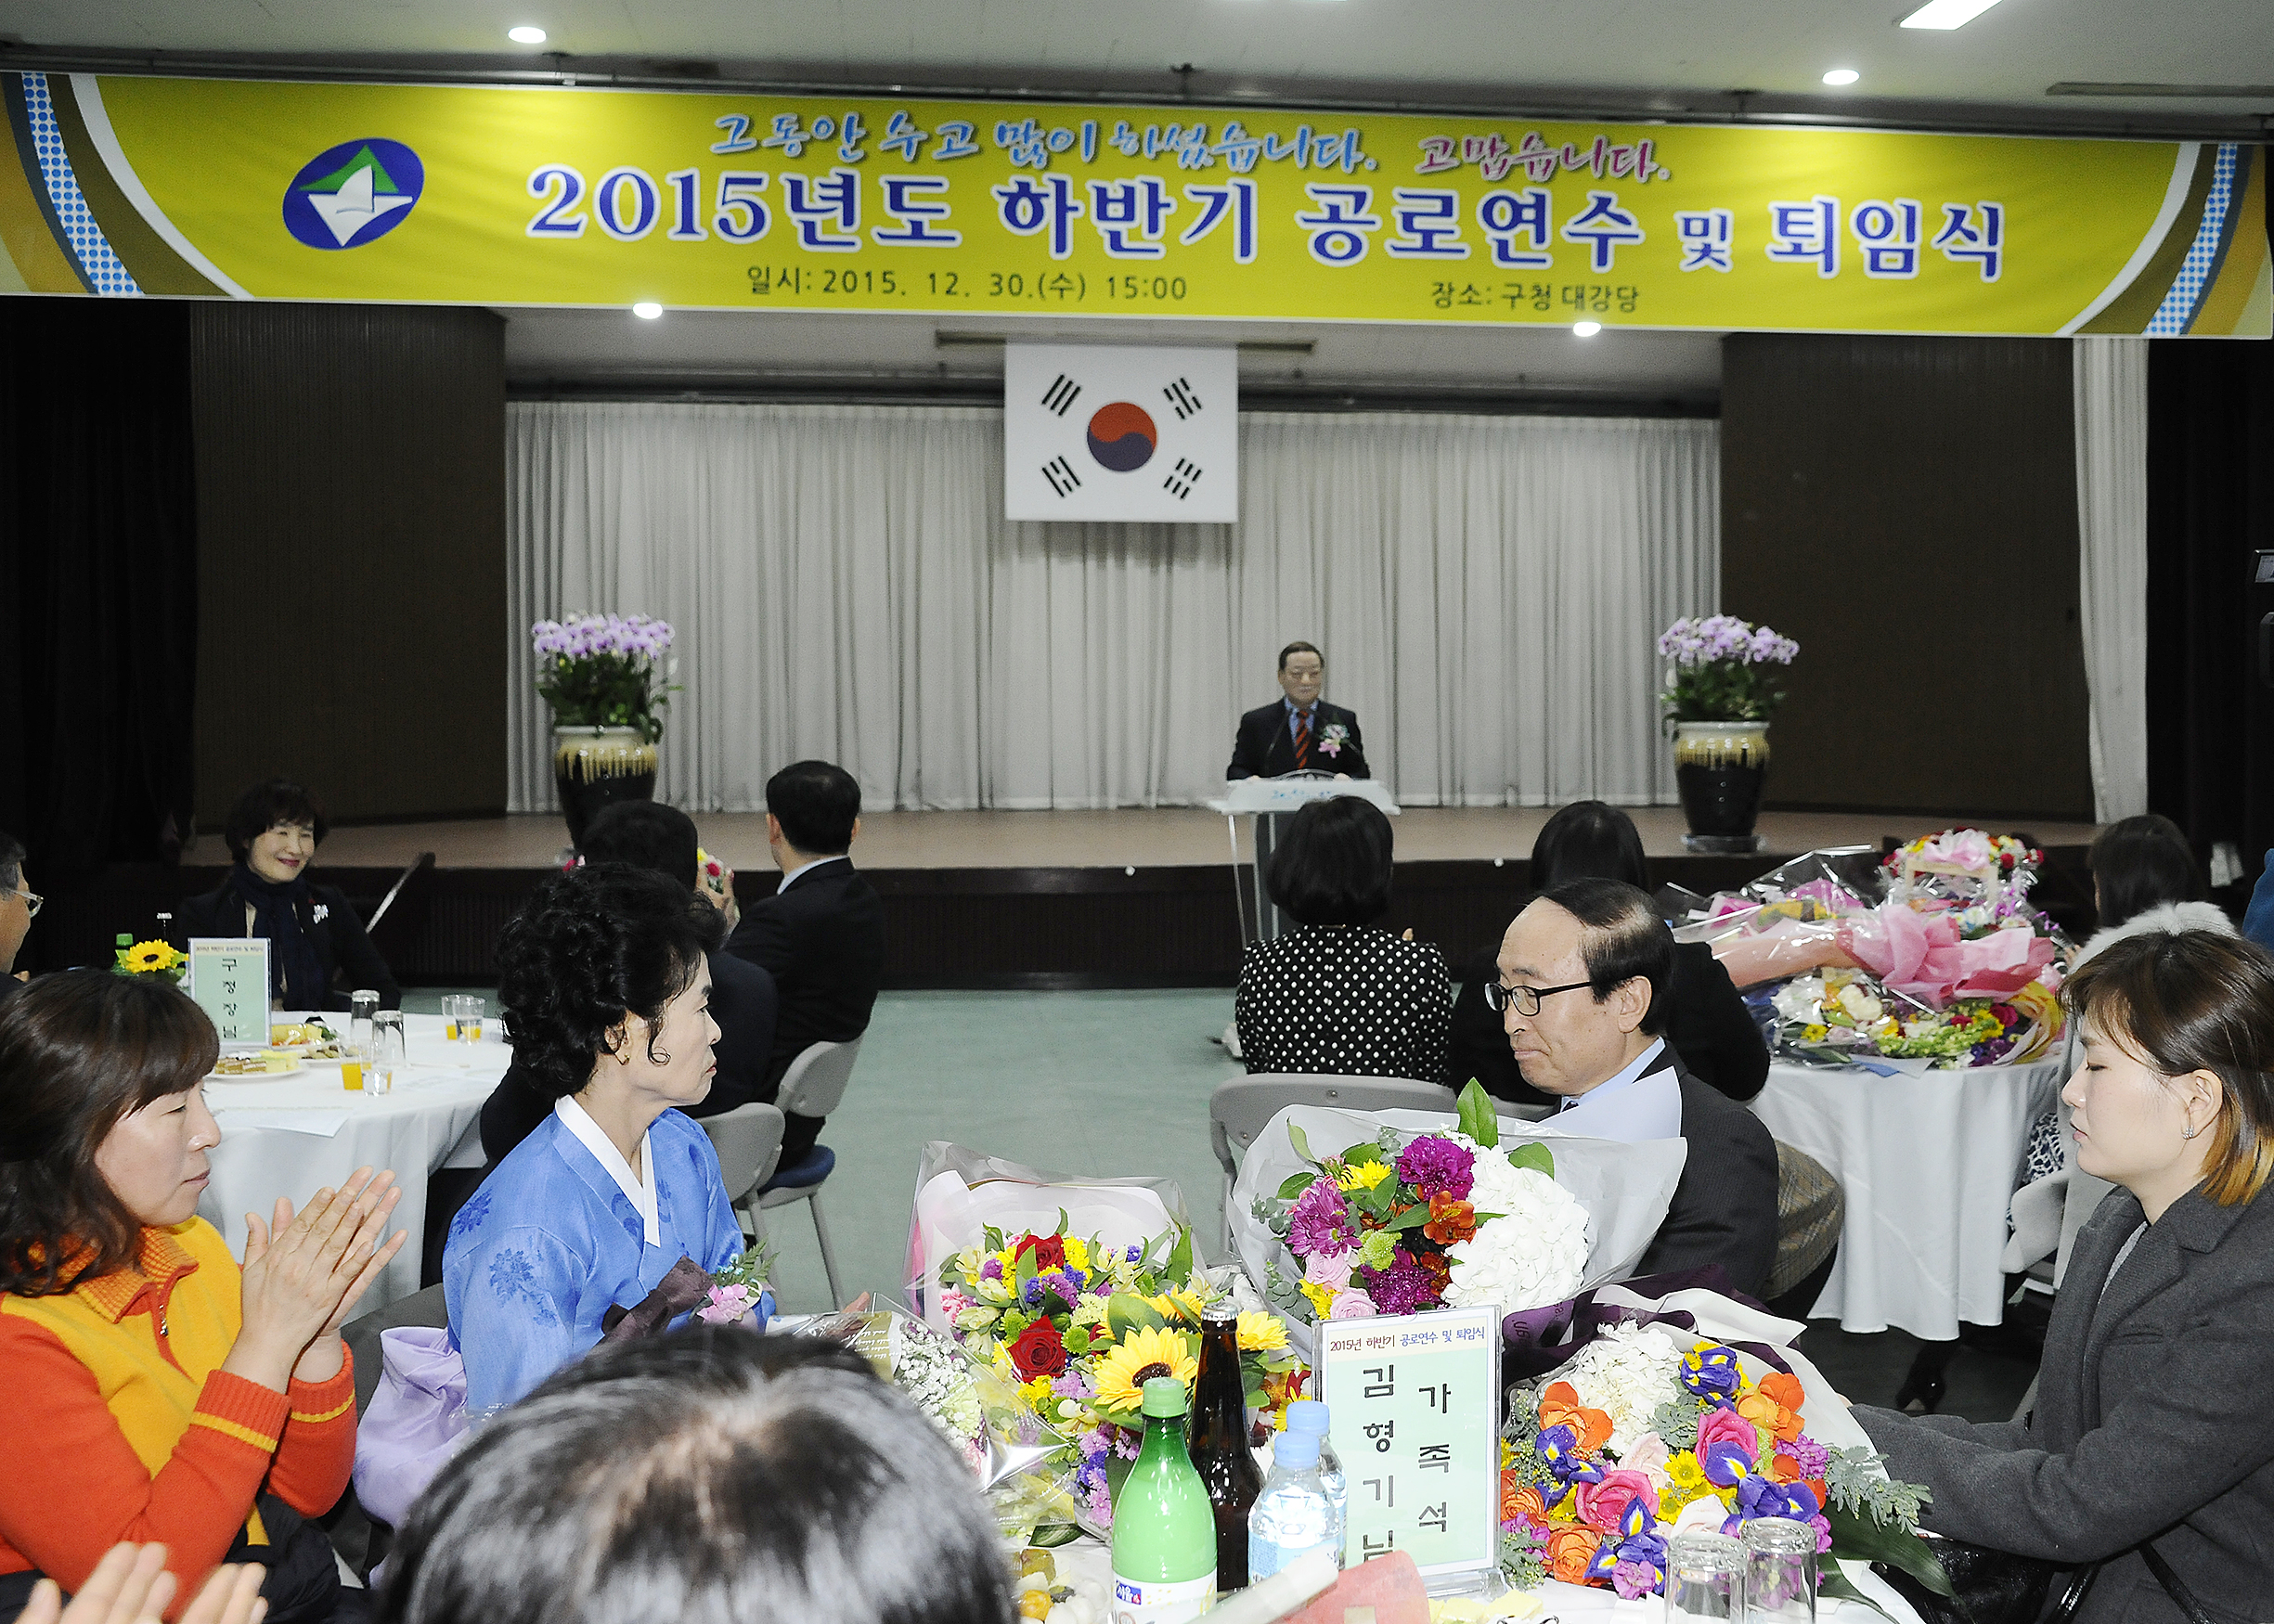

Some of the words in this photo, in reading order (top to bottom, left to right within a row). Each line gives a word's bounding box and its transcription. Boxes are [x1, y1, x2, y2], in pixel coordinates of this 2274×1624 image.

[710, 111, 867, 161] 그동안
[879, 110, 979, 161] 수고
[994, 118, 1097, 169] 많이
[1415, 133, 1671, 182] 고맙습니다.
[526, 167, 962, 251] 2015년도
[991, 172, 1259, 264] 하반기
[1296, 183, 1645, 272] 공로연수
[1674, 208, 1733, 273] 및
[1767, 193, 2007, 282] 퇴임식
[747, 265, 811, 295] 일시:
[823, 269, 907, 297] 2015.
[928, 272, 971, 297] 12.
[988, 273, 1087, 302] 30.(수)
[1107, 276, 1187, 300] 15:00
[1432, 281, 1492, 308] 장소:
[1500, 282, 1552, 311] 구청
[1561, 284, 1639, 313] 대강당
[1330, 1337, 1362, 1351] 2015년
[1366, 1334, 1395, 1349] 하반기
[1400, 1331, 1439, 1347] 공로연수
[1442, 1329, 1452, 1343] 및
[1456, 1326, 1485, 1341] 퇴임식
[1418, 1383, 1452, 1532] 가족석
